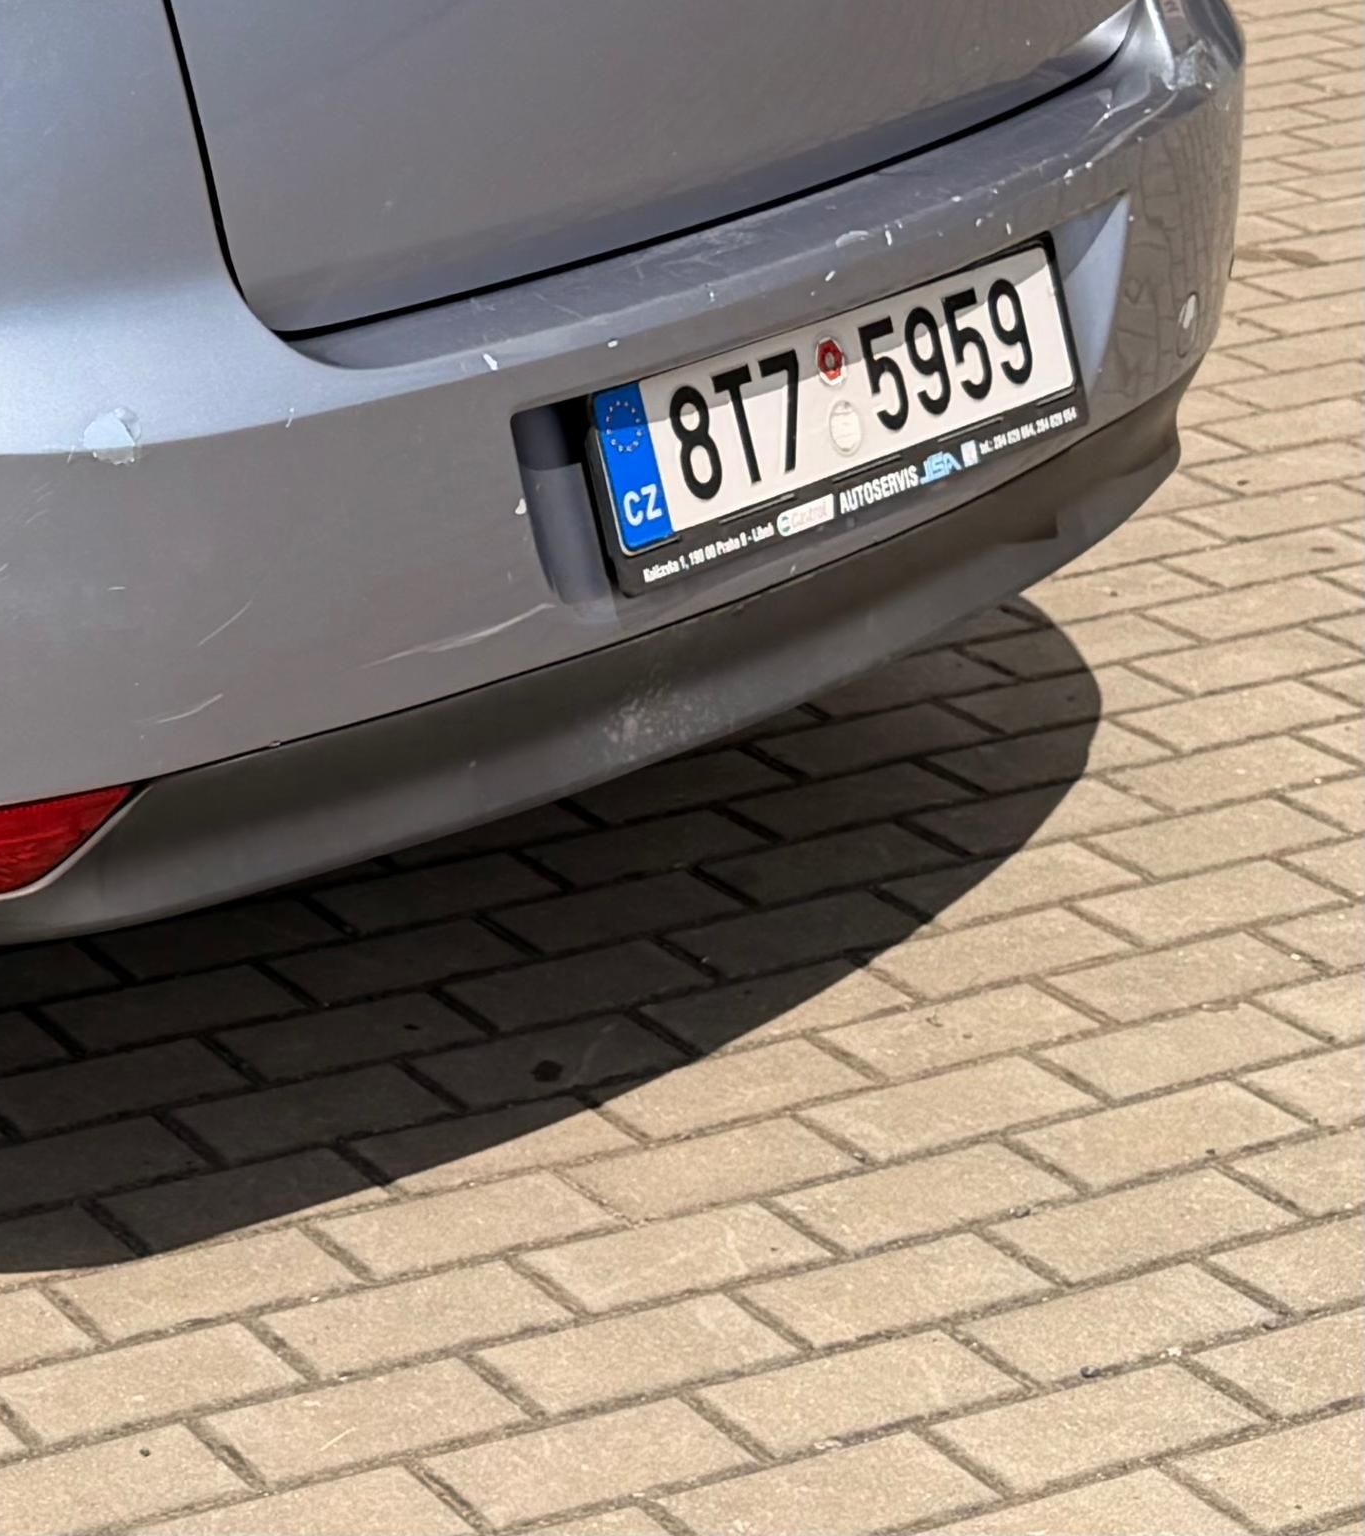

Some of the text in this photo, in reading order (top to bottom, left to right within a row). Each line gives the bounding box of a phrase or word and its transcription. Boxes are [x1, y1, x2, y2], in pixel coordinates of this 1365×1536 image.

[669, 278, 1034, 500] 8T7 5959
[623, 483, 663, 528] CZ
[839, 465, 919, 514] AUTOSERVIS
